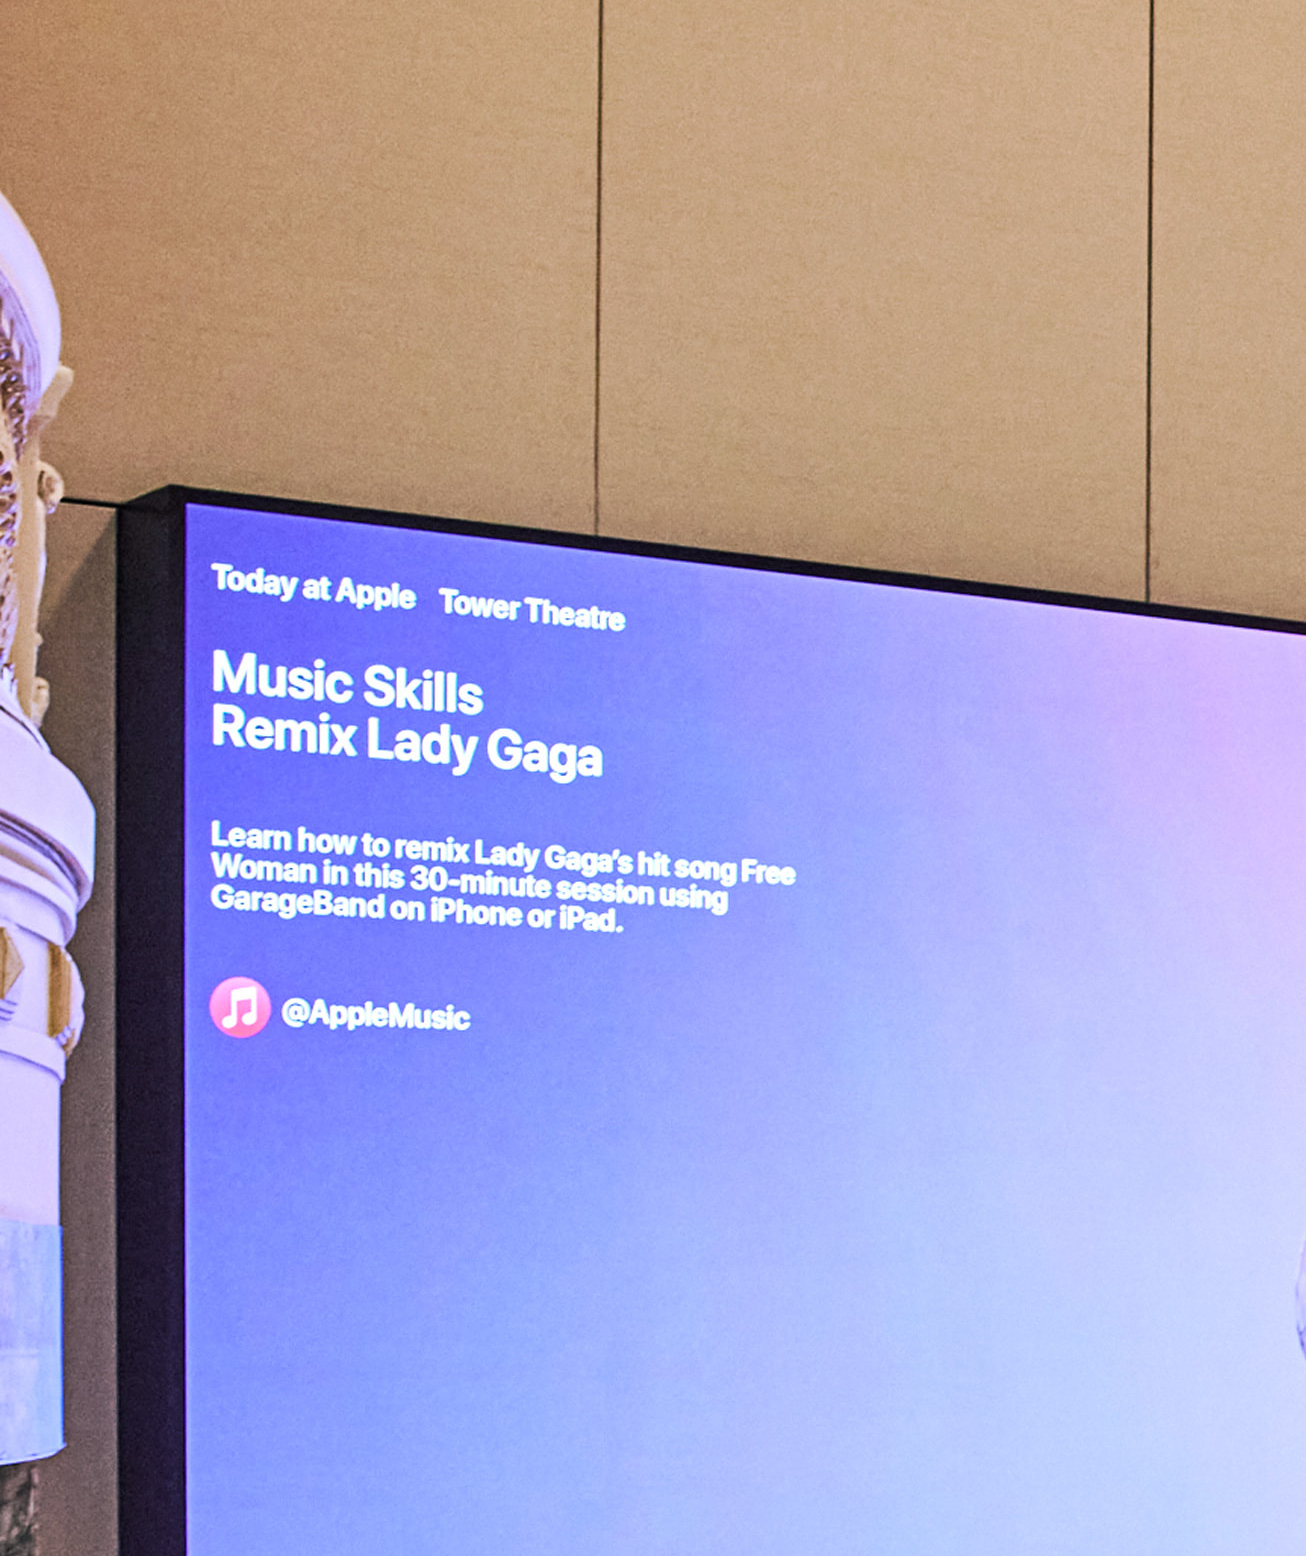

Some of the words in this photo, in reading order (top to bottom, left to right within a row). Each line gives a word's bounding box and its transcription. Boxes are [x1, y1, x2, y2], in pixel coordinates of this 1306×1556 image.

[210, 562, 299, 602] Today
[302, 576, 331, 601] at
[334, 576, 416, 611] Apple
[438, 587, 521, 621] Tower
[523, 596, 626, 632] Theatre
[213, 649, 353, 704] Music
[363, 664, 483, 715] Skills
[212, 702, 357, 757] Remix
[367, 716, 479, 776] Lady
[486, 728, 603, 784] Gaga
[210, 851, 317, 884] Woman
[322, 858, 348, 886] in
[352, 861, 405, 889] this
[409, 864, 552, 899] 30-minute
[555, 878, 655, 906] session
[658, 883, 729, 916] using
[211, 819, 291, 851] Learn
[297, 826, 358, 856] how
[360, 832, 390, 858] to
[394, 836, 470, 864] remix
[474, 838, 541, 873] Lady
[637, 850, 671, 877] hit
[673, 858, 738, 888] song
[740, 858, 797, 886] Free
[210, 883, 385, 920] GarageBand
[389, 899, 425, 922] on
[430, 896, 523, 927] iPhone
[526, 908, 557, 929] or
[559, 904, 624, 933] iPad.
[281, 997, 471, 1031] @AppleMusic
